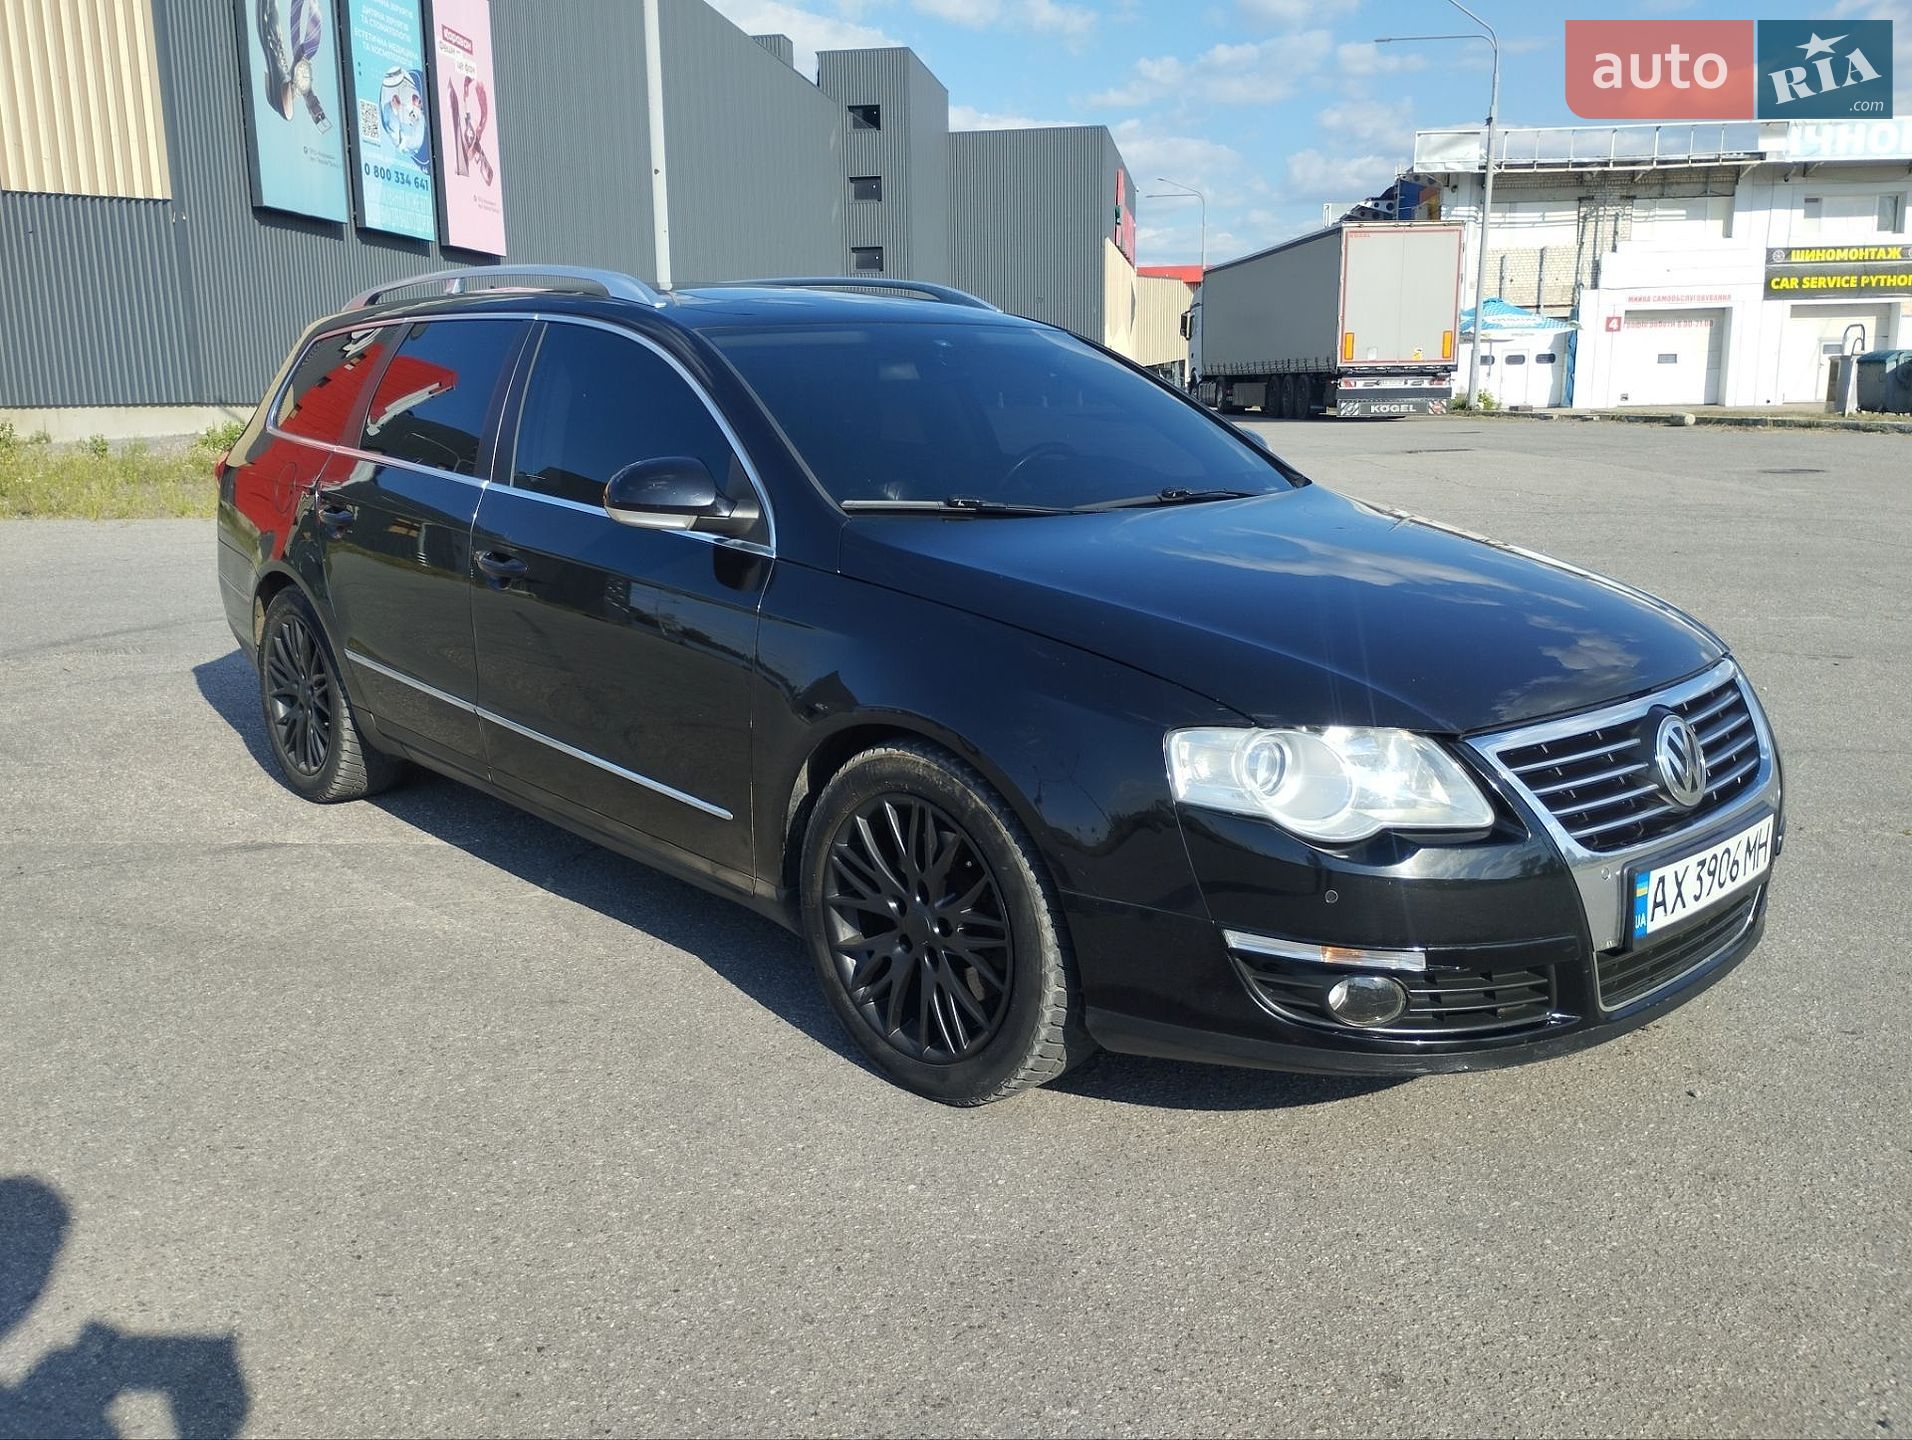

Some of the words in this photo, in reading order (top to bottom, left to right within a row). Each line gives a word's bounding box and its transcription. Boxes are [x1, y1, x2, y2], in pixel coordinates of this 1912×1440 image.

[364, 162, 370, 176] 0
[373, 165, 392, 181] 800
[394, 170, 411, 187] 334
[414, 176, 429, 191] 641
[1790, 247, 1902, 262] ШИНОМОНТАЖ
[1770, 276, 1799, 290] CAR
[1801, 275, 1858, 289] SERVICE
[1608, 318, 1618, 330] 4
[1370, 403, 1417, 413] KÖGEL
[1650, 865, 1690, 922] AX
[1693, 840, 1742, 902] 3906
[1743, 822, 1771, 876] MH
[1635, 914, 1647, 929] UA
